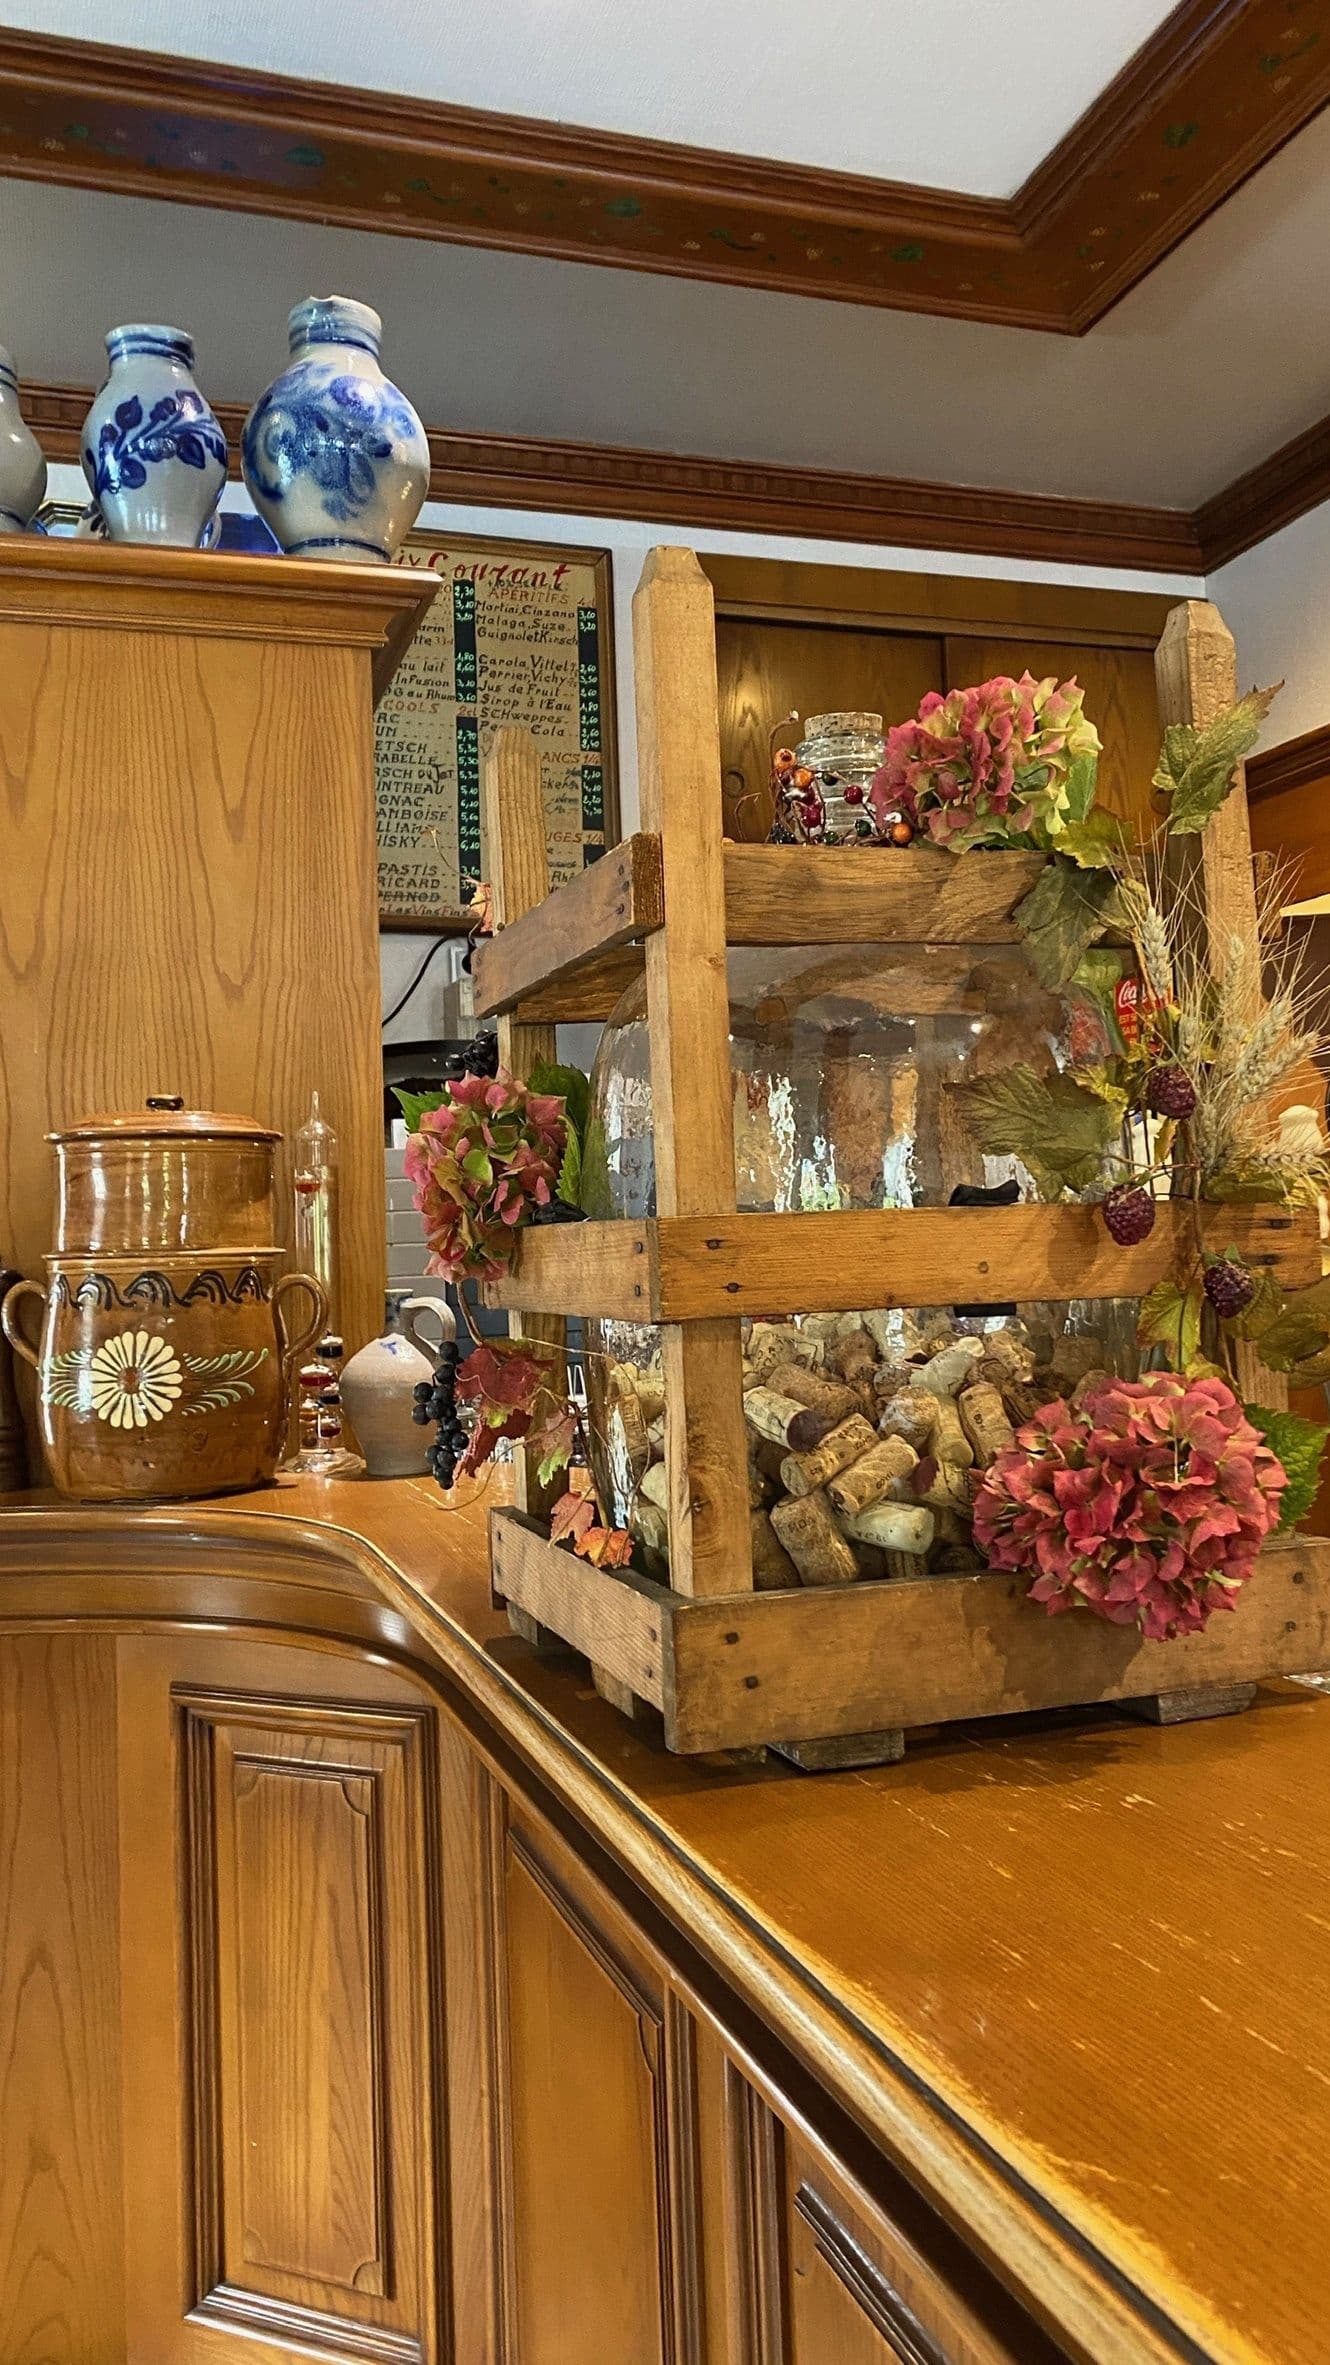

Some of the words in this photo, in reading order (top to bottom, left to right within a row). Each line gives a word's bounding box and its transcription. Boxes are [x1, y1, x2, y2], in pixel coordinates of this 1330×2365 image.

[396, 549, 421, 566] ix
[427, 551, 571, 591] Courant
[454, 585, 475, 599] 2,30
[455, 599, 475, 610] 3,10
[419, 623, 445, 633] arin
[456, 652, 475, 662] 1,80
[423, 661, 445, 673] lait
[456, 662, 475, 673] 2,60
[457, 678, 476, 688] 3,10
[531, 669, 568, 687] Vichy
[477, 680, 502, 692] Jus
[508, 683, 523, 695] de
[526, 683, 560, 697] Fruit
[383, 700, 440, 714] COOLS
[480, 693, 519, 710] Sirop
[580, 702, 599, 713] 1,80
[377, 712, 400, 724] RC
[375, 725, 397, 738] UM
[530, 724, 565, 737] Cola
[375, 740, 428, 754] ETSCH
[458, 743, 478, 754] 5,30
[374, 752, 439, 766] RABELLE
[458, 756, 479, 767] 5,30
[542, 751, 581, 764] ANCS
[374, 766, 413, 779] RSCH
[459, 770, 479, 780] 5,30
[376, 781, 445, 795] INTREAU
[460, 785, 479, 796] 5,10
[378, 794, 426, 807] GNAC
[376, 807, 449, 821] AMBOISE
[460, 811, 479, 822] 5,60
[375, 820, 422, 834] LLIAM
[460, 825, 480, 837] 5,60
[376, 834, 421, 849] HISKY
[460, 840, 480, 852] 6,10
[377, 862, 438, 876] PASTIS
[377, 875, 441, 889] RICARD
